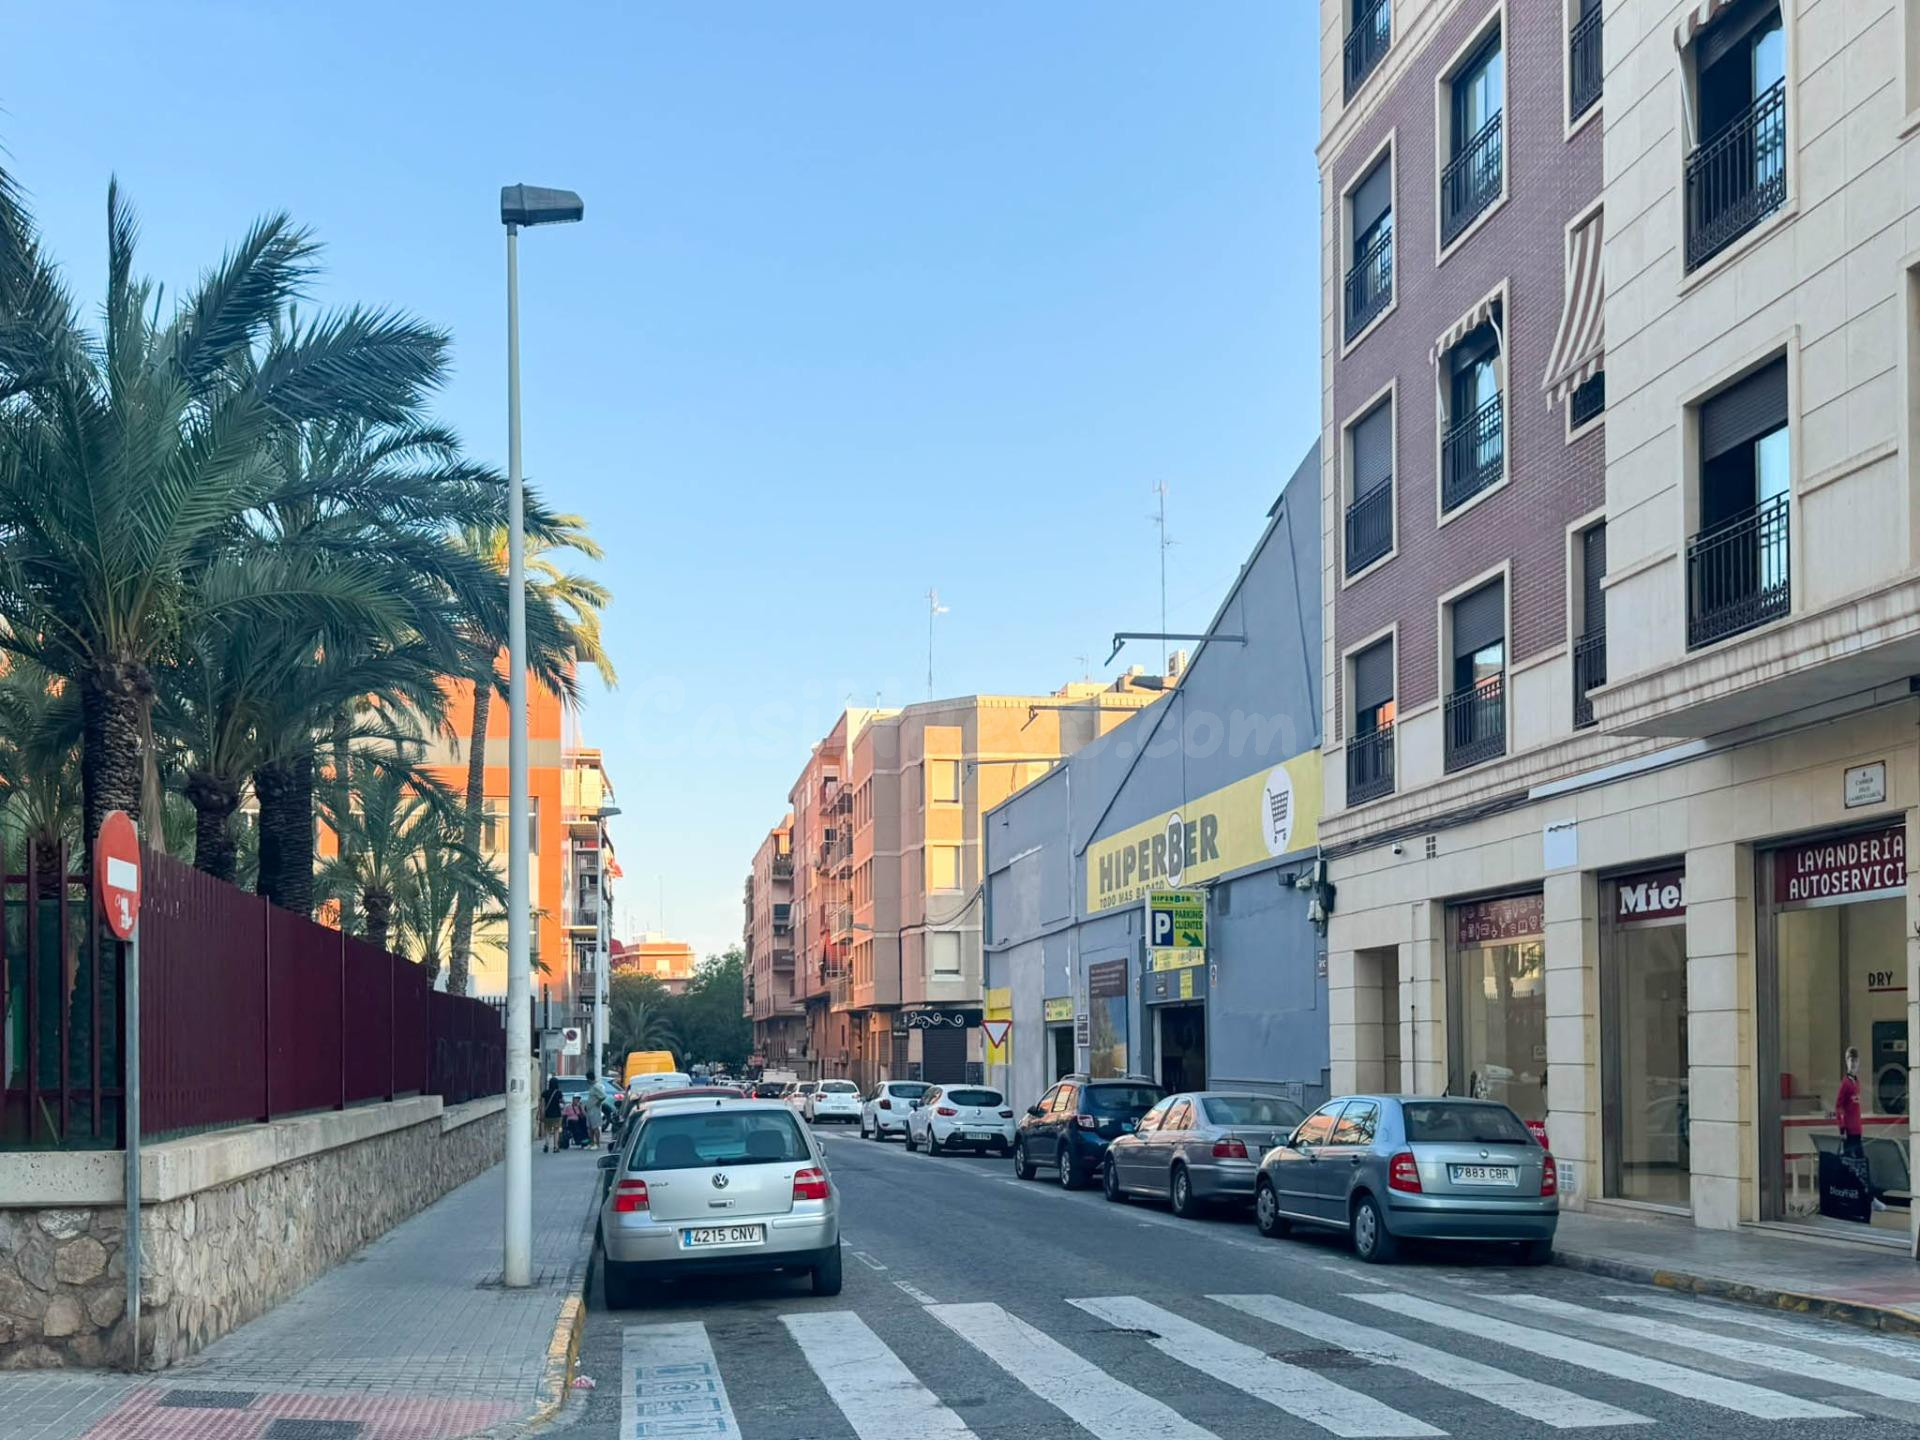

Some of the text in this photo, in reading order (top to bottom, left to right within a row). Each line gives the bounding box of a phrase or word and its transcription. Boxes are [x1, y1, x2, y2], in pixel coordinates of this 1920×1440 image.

[1100, 814, 1219, 894] HIPERBER
[1797, 830, 1903, 873] LAVANDERÍA
[1790, 862, 1904, 899] AUTOSERVICI
[1175, 910, 1203, 920] PARKING
[1155, 912, 1171, 944] P
[1175, 920, 1203, 930] CLIENTES
[1868, 971, 1893, 986] DRY
[1459, 1167, 1485, 1178] 7883
[694, 1227, 755, 1242] 4215 CNV
